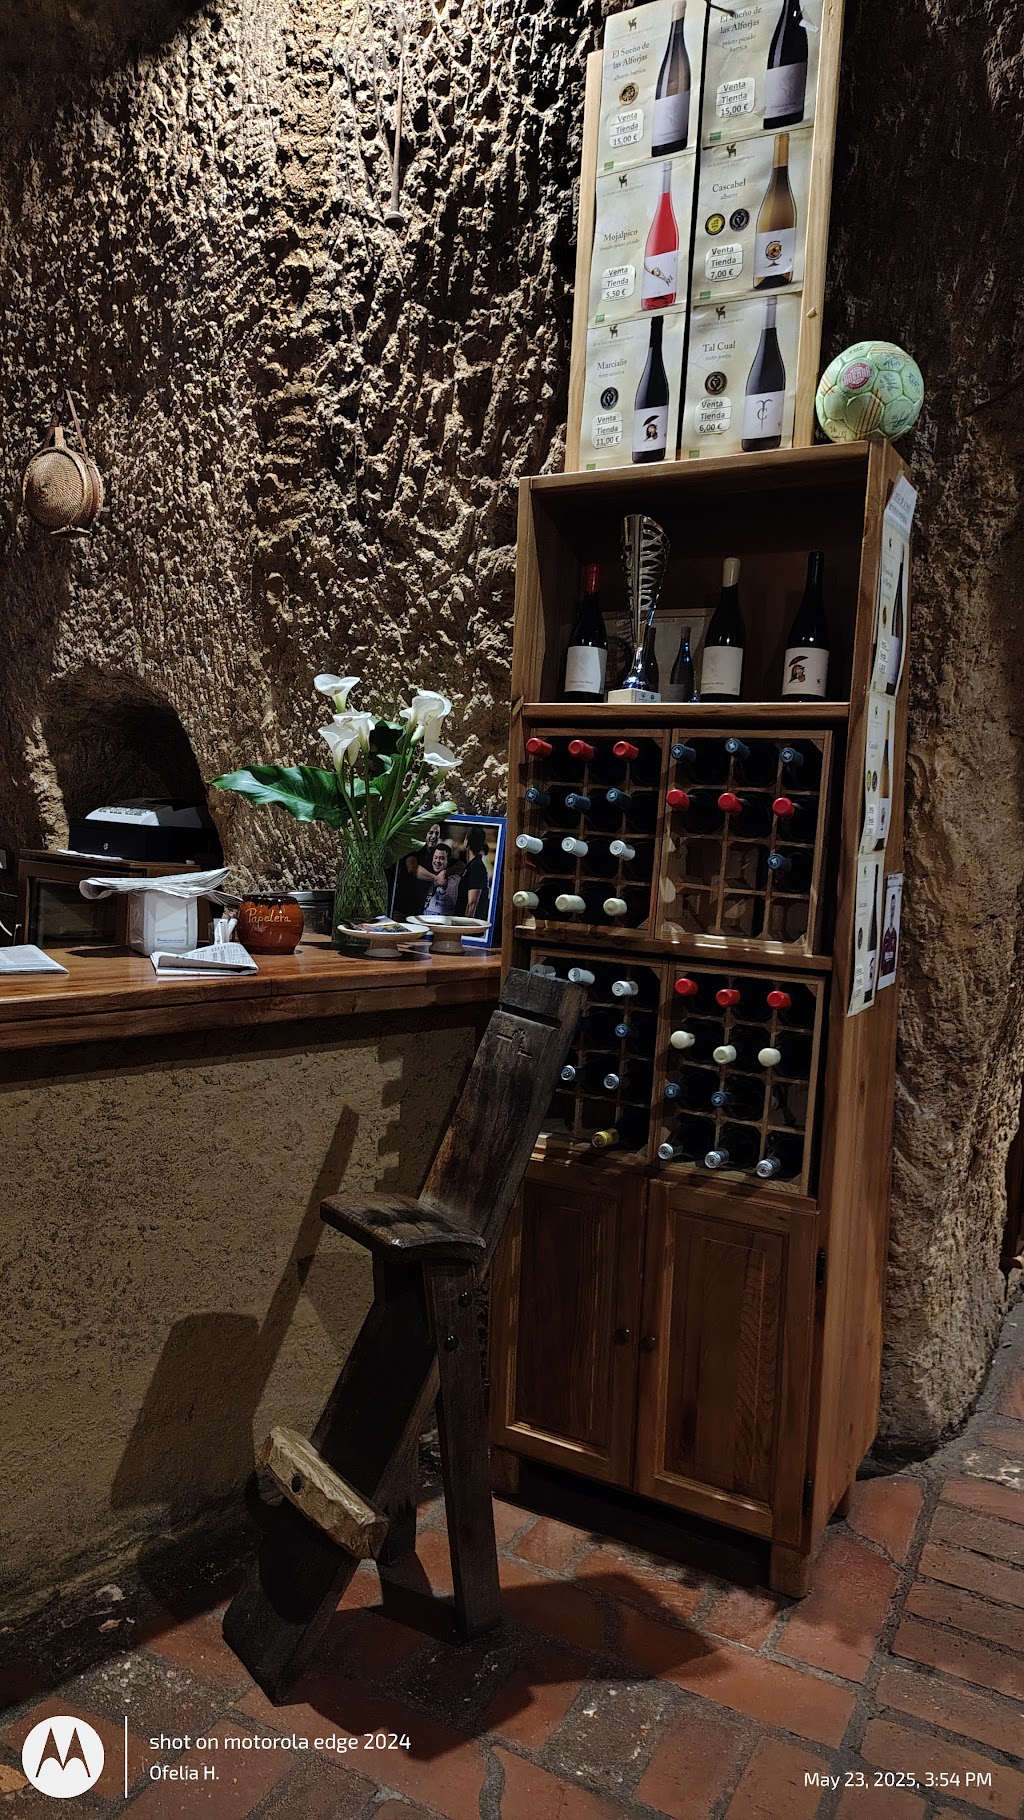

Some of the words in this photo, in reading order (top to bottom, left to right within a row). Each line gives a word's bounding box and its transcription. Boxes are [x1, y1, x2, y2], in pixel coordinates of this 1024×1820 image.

[720, 14, 728, 23] El
[753, 6, 762, 14] de
[720, 26, 730, 34] las
[730, 20, 760, 32] Alforjas
[612, 50, 620, 59] El
[641, 42, 650, 50] de
[612, 61, 622, 69] las
[622, 54, 648, 67] Alforjas
[723, 81, 746, 91] Venta
[721, 92, 748, 103] Tienda
[721, 104, 742, 116] 15,00
[743, 103, 749, 111] €
[617, 112, 638, 122] Venta
[615, 122, 639, 134] Tienda
[613, 135, 632, 146] 15,00
[633, 133, 639, 141] €
[712, 177, 746, 192] Cascabel
[603, 229, 638, 242] Mojalpico
[711, 246, 734, 255] Venta
[710, 256, 737, 267] Tienda
[608, 267, 629, 276] Venta
[710, 269, 727, 280] 7,00
[728, 268, 734, 276] €
[606, 277, 629, 287] Tienda
[606, 289, 621, 299] 5,50
[621, 288, 626, 296] €
[702, 343, 716, 353] Tal
[716, 340, 736, 351] Cual
[597, 358, 628, 371] Marcialis
[701, 400, 724, 409] Venta
[597, 415, 617, 424] Venta
[700, 411, 726, 420] Tienda
[596, 425, 618, 435] Tienda
[699, 423, 716, 433] 6,00
[596, 436, 614, 446] 11,00
[615, 435, 620, 443] €
[245, 908, 291, 930] Papelera
